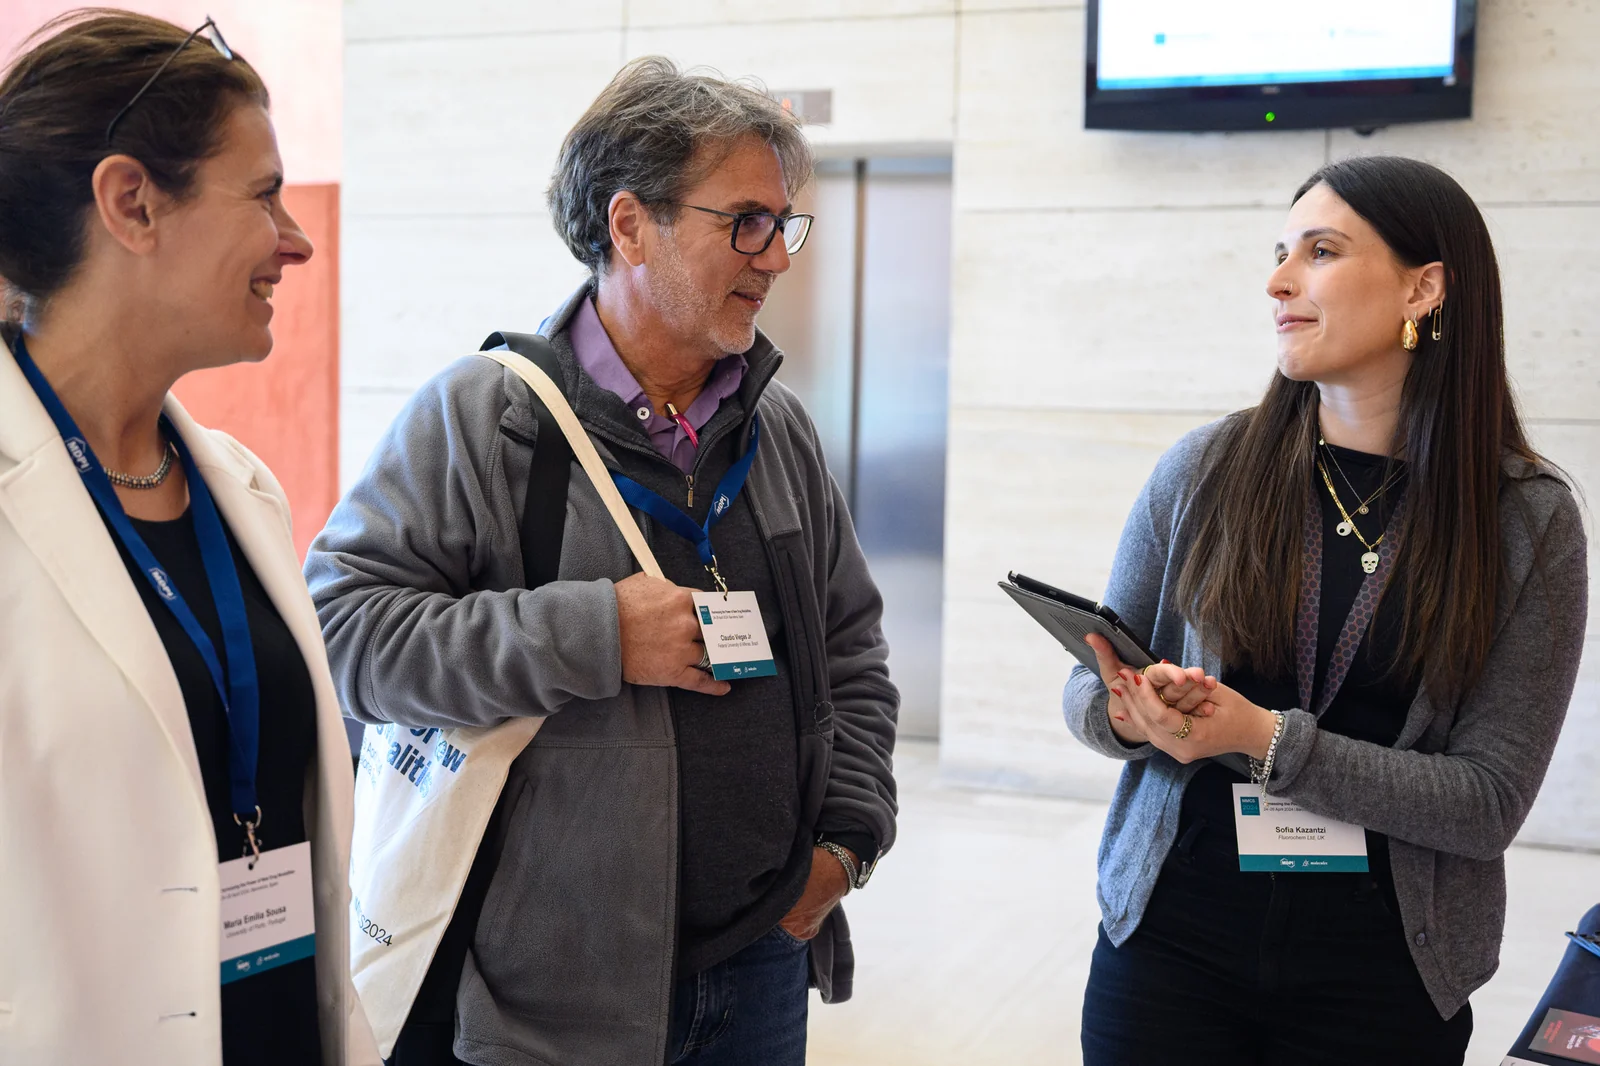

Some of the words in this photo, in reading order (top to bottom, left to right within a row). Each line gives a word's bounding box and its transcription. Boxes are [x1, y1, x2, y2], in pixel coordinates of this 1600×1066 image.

[67, 441, 90, 470] MDPI
[151, 571, 174, 598] MDPI
[224, 918, 242, 929] Maria
[266, 905, 286, 918] Sousa
